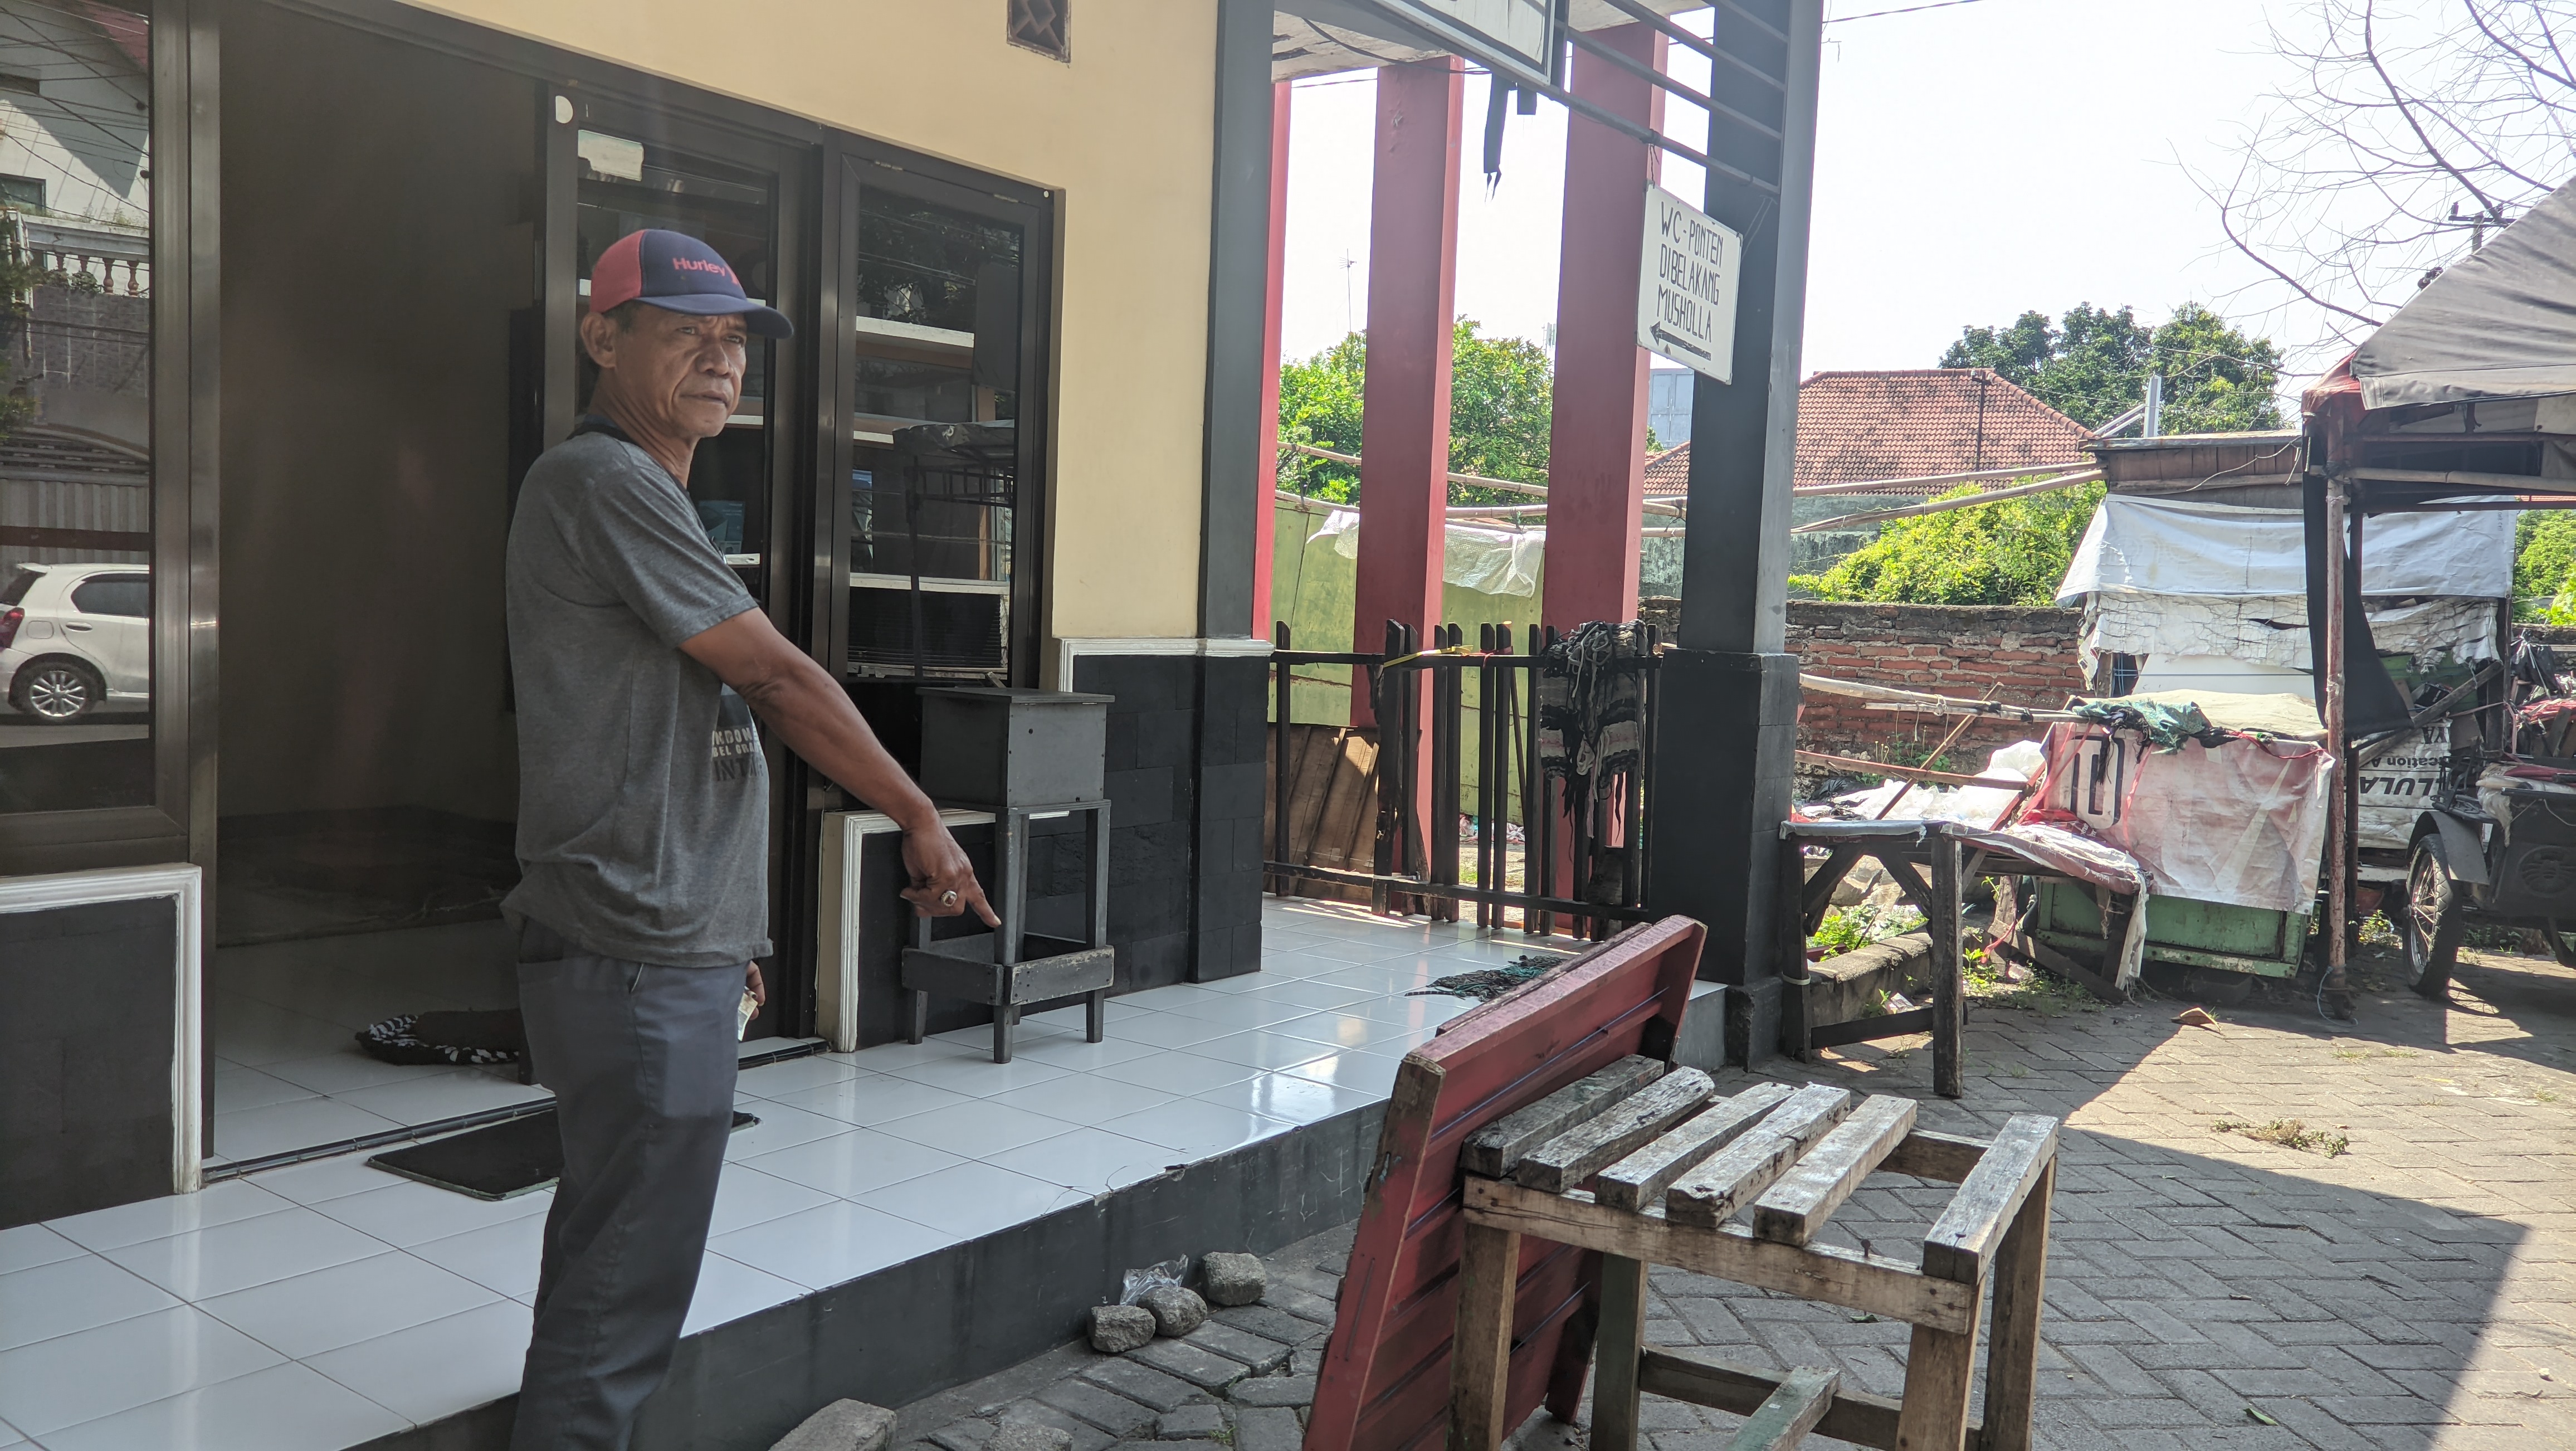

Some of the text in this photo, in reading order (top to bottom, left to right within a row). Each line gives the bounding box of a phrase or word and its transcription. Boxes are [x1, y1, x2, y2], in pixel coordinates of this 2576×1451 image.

[672, 257, 725, 276] Hurley
[1660, 244, 1720, 305] DIBELAKANG
[1657, 284, 1712, 343] MUSHOLLA
